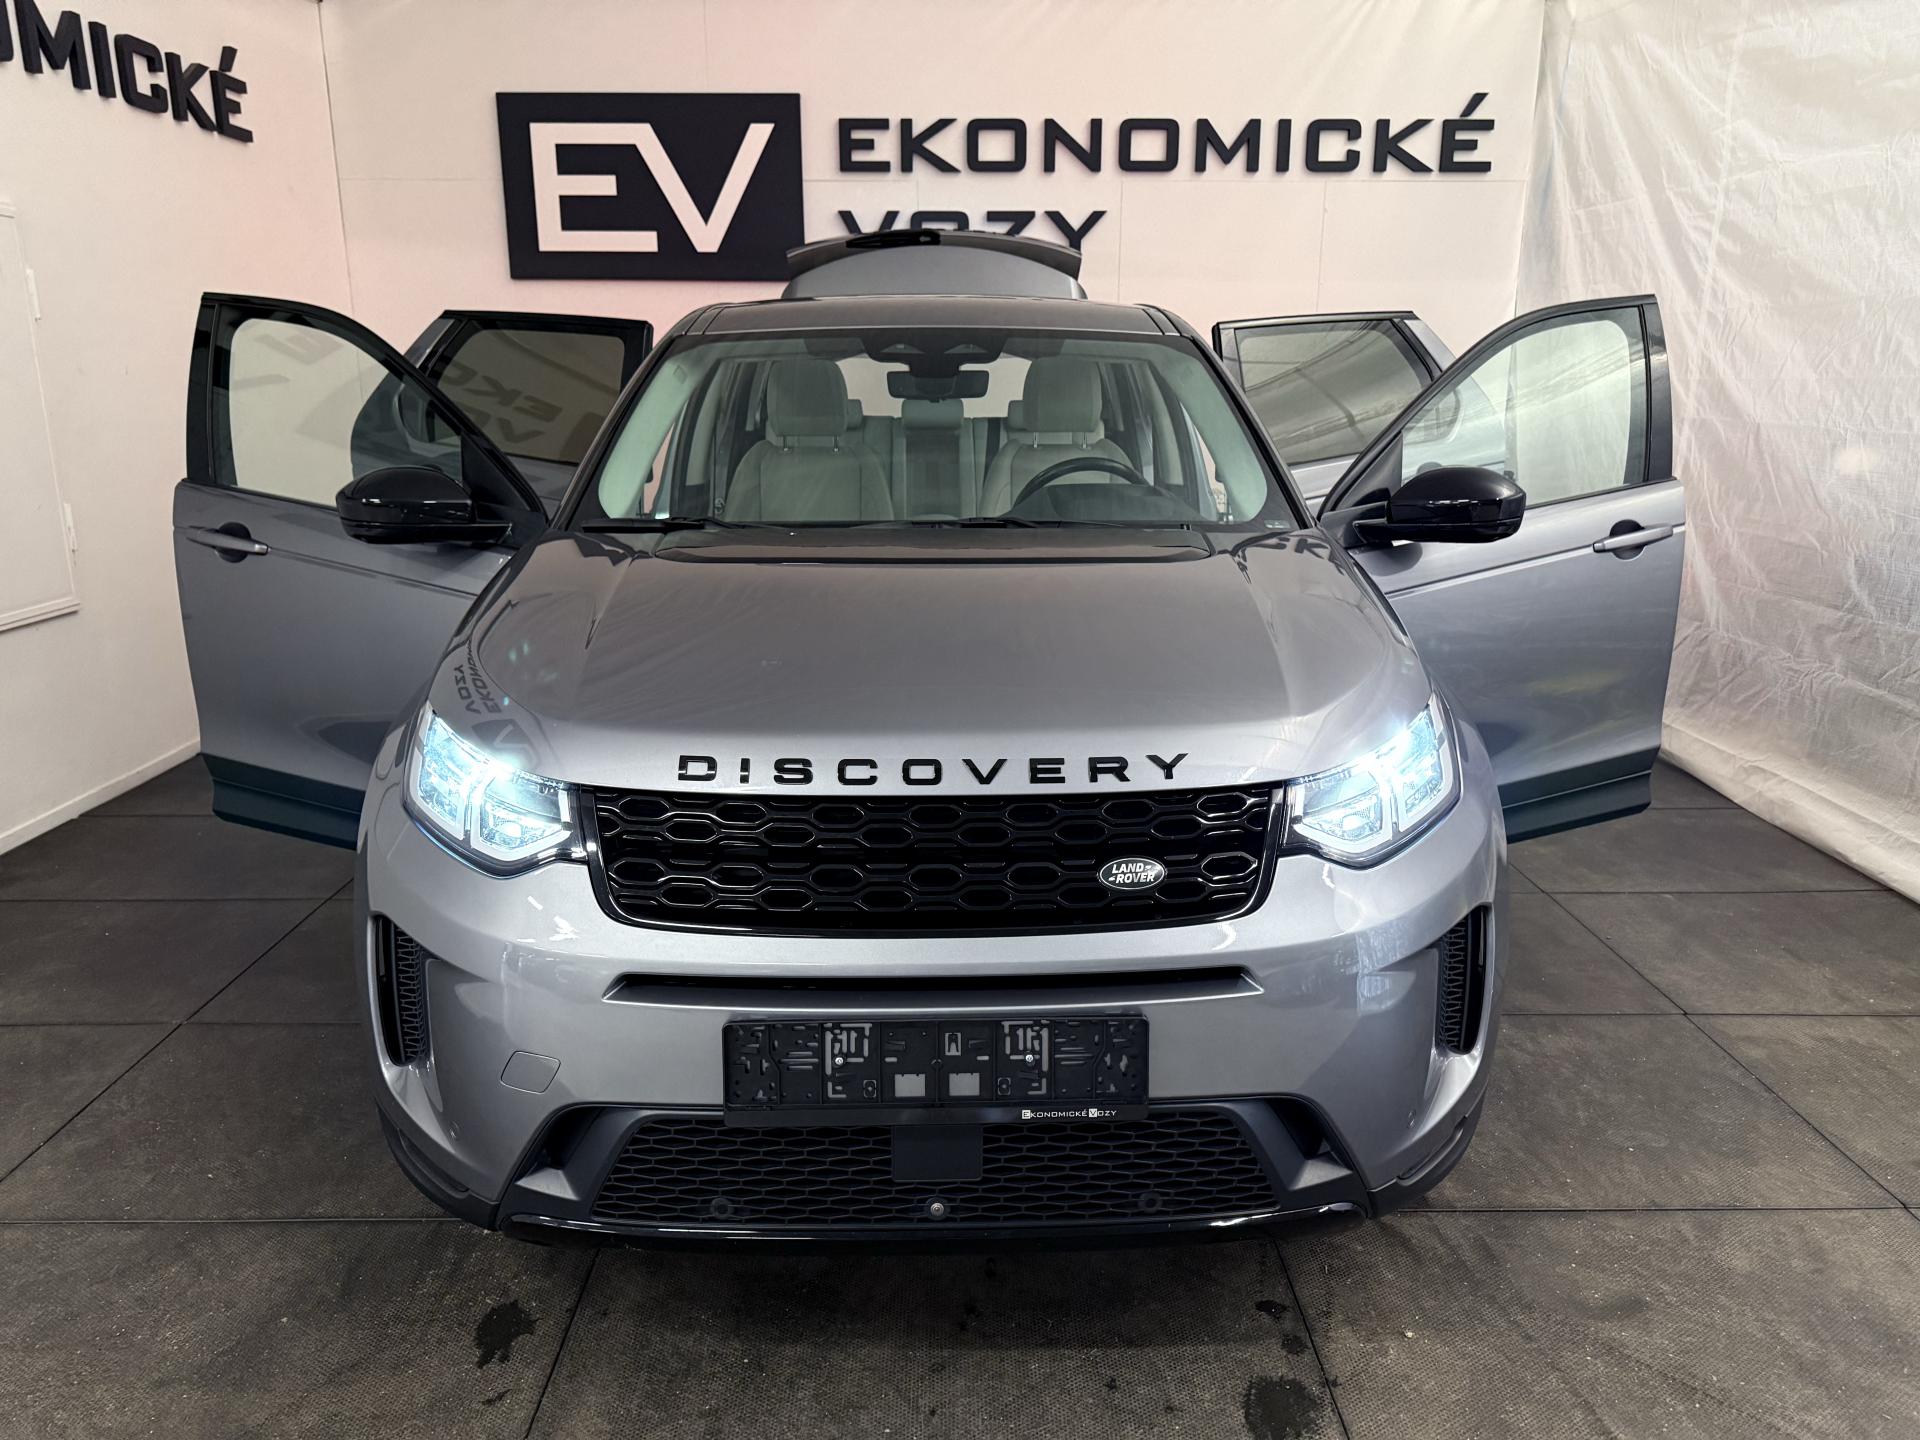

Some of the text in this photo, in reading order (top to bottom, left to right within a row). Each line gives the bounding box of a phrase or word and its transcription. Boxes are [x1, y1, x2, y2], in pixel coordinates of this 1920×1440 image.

[838, 92, 1495, 173] EKONOMICKÉ
[529, 122, 775, 252] EV
[678, 753, 1188, 786] DISCOVERY
[1112, 863, 1144, 874] LAND
[1115, 872, 1155, 884] ROVER
[1021, 1108, 1117, 1120] EKONOMICKÉ VOZY
